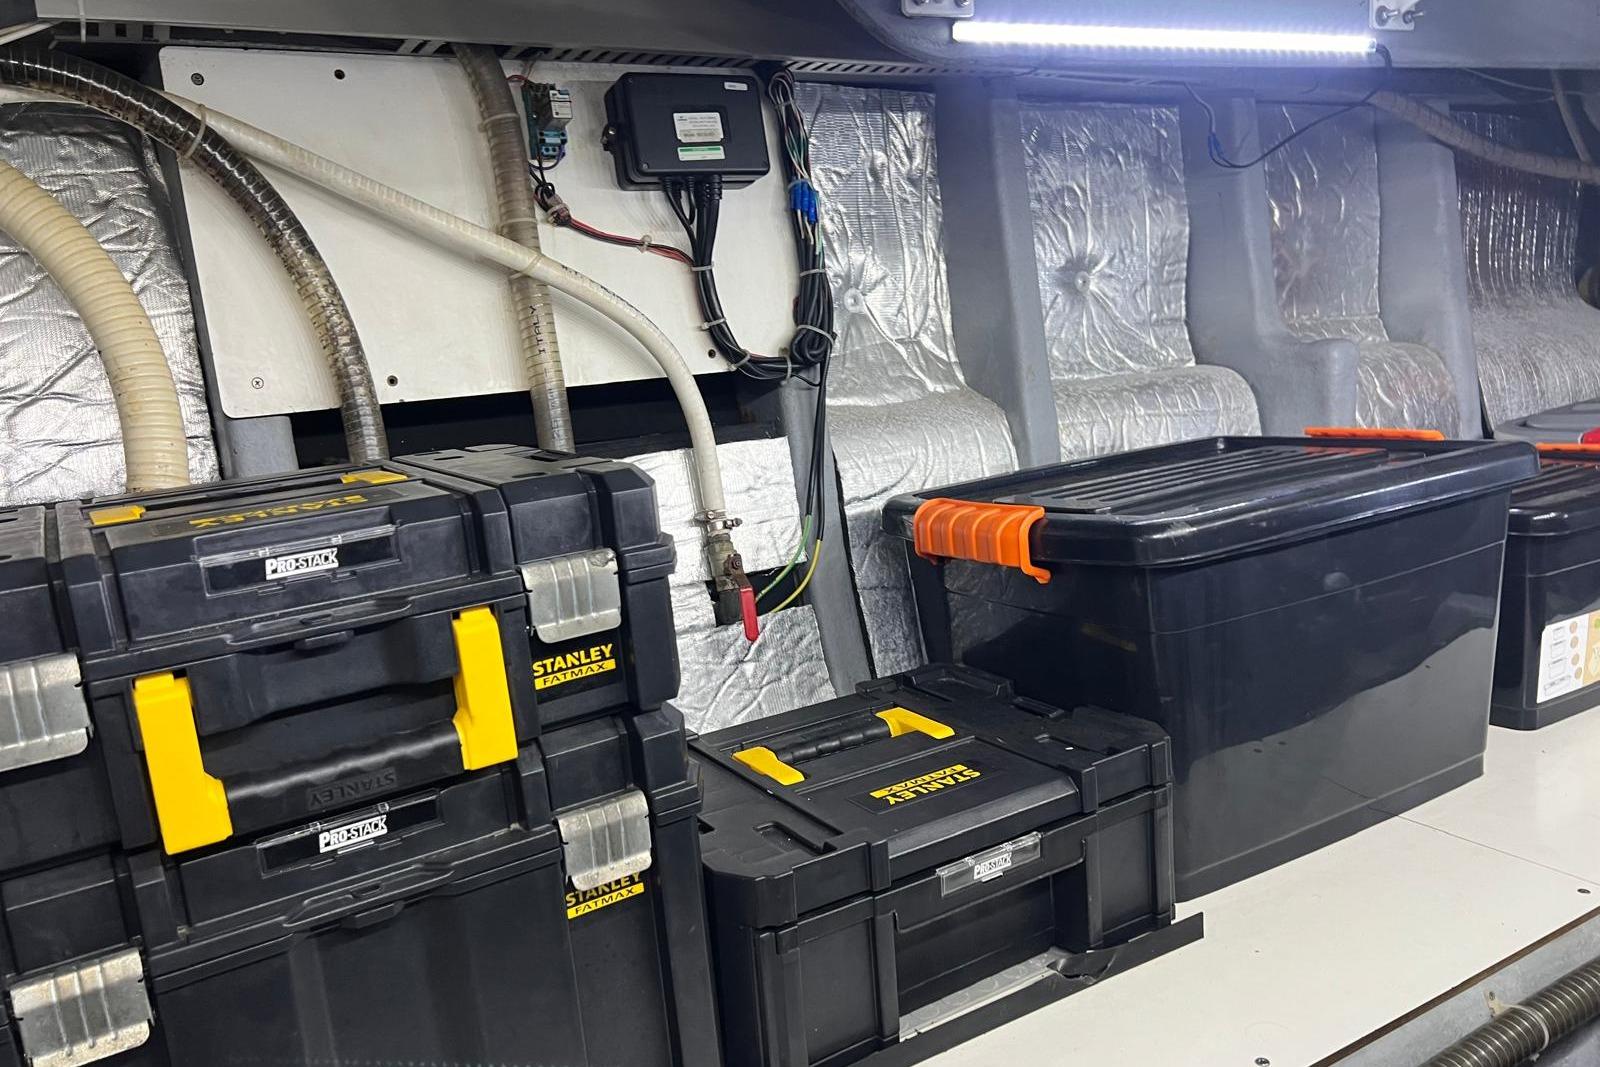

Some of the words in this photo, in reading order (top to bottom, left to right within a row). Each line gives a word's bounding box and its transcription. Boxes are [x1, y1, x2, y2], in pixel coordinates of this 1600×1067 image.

[265, 548, 338, 578] PRO-STACK
[532, 643, 613, 677] STANLEY
[543, 662, 606, 686] FATMAX
[309, 771, 396, 807] STANLEY
[884, 766, 958, 794] FATMAX
[884, 768, 981, 805] STANLEY
[319, 815, 387, 850] PRO-STACK
[973, 852, 1012, 879] PRO-STACK
[575, 886, 634, 915] FATMAX
